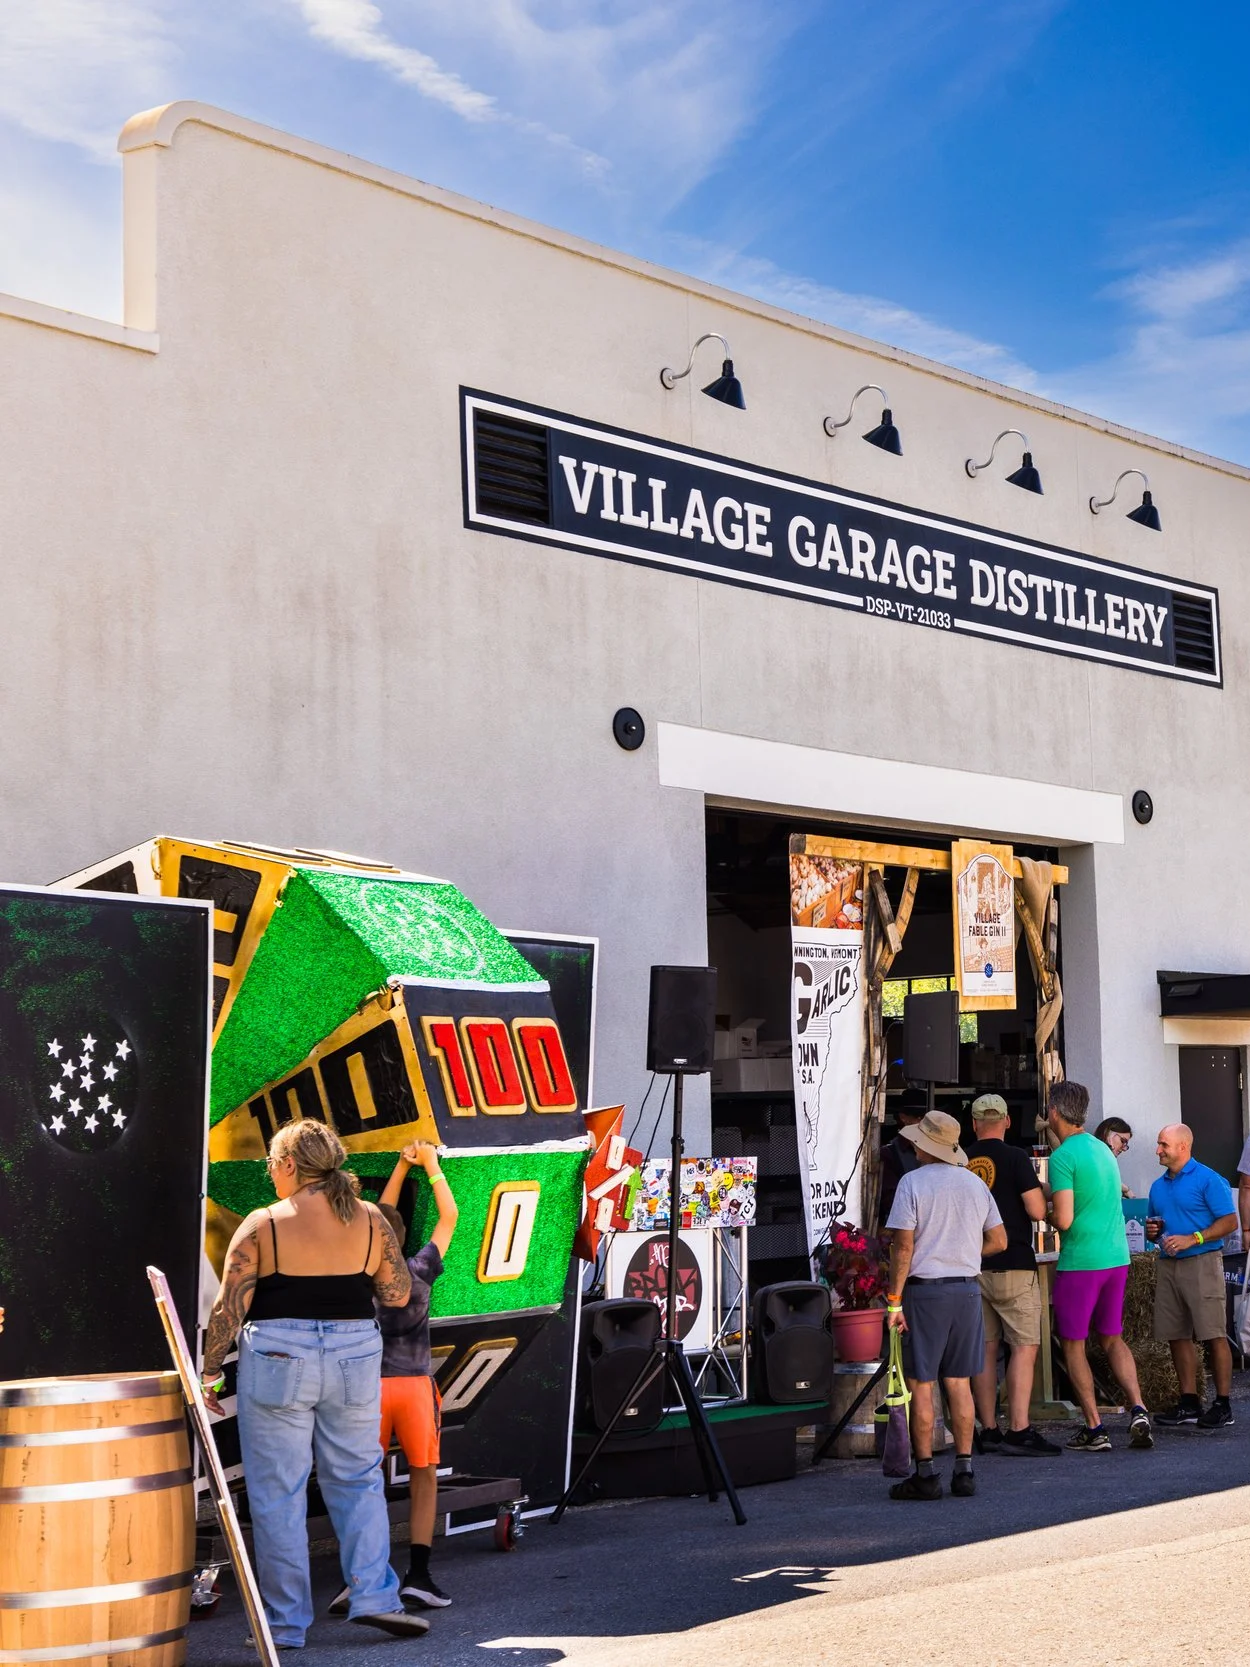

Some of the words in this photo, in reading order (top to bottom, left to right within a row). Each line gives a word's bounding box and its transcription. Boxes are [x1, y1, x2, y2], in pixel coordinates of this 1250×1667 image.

[557, 455, 775, 558] VILLAGE
[787, 515, 957, 601] GARAGE
[970, 557, 1169, 648] DISTILLERY
[865, 594, 952, 629] DSP-VT-21033
[974, 913, 1001, 924] VILLAGE
[968, 925, 988, 937] FABLE
[989, 926, 1000, 936] GIN
[421, 1016, 578, 1117] 100
[824, 1180, 849, 1197] DAY
[812, 1200, 847, 1220] KEND
